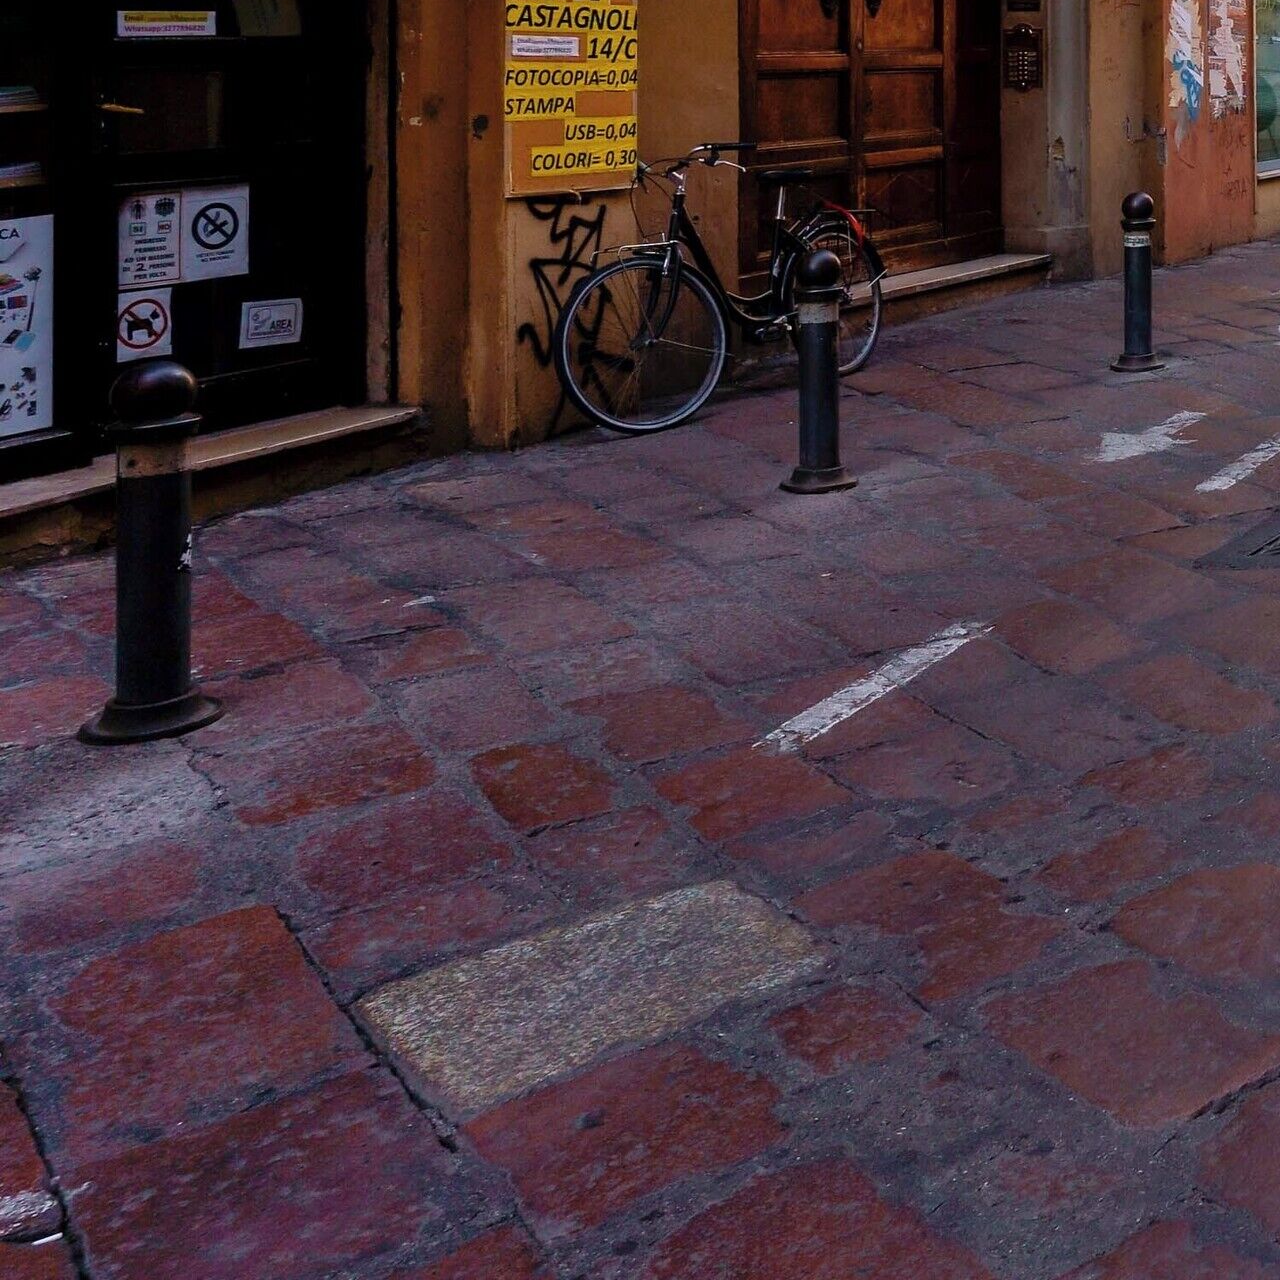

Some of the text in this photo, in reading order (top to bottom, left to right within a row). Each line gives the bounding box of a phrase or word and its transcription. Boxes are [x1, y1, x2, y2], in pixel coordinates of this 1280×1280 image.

[505, 4, 637, 31] CASTAGNOLI
[588, 36, 637, 63] 14/C
[505, 69, 637, 88] FOTOCOPIA=0,04
[505, 97, 574, 115] STAMPA
[565, 122, 636, 141] USB=0,04
[605, 149, 637, 169] 0,30
[135, 263, 147, 272] 2
